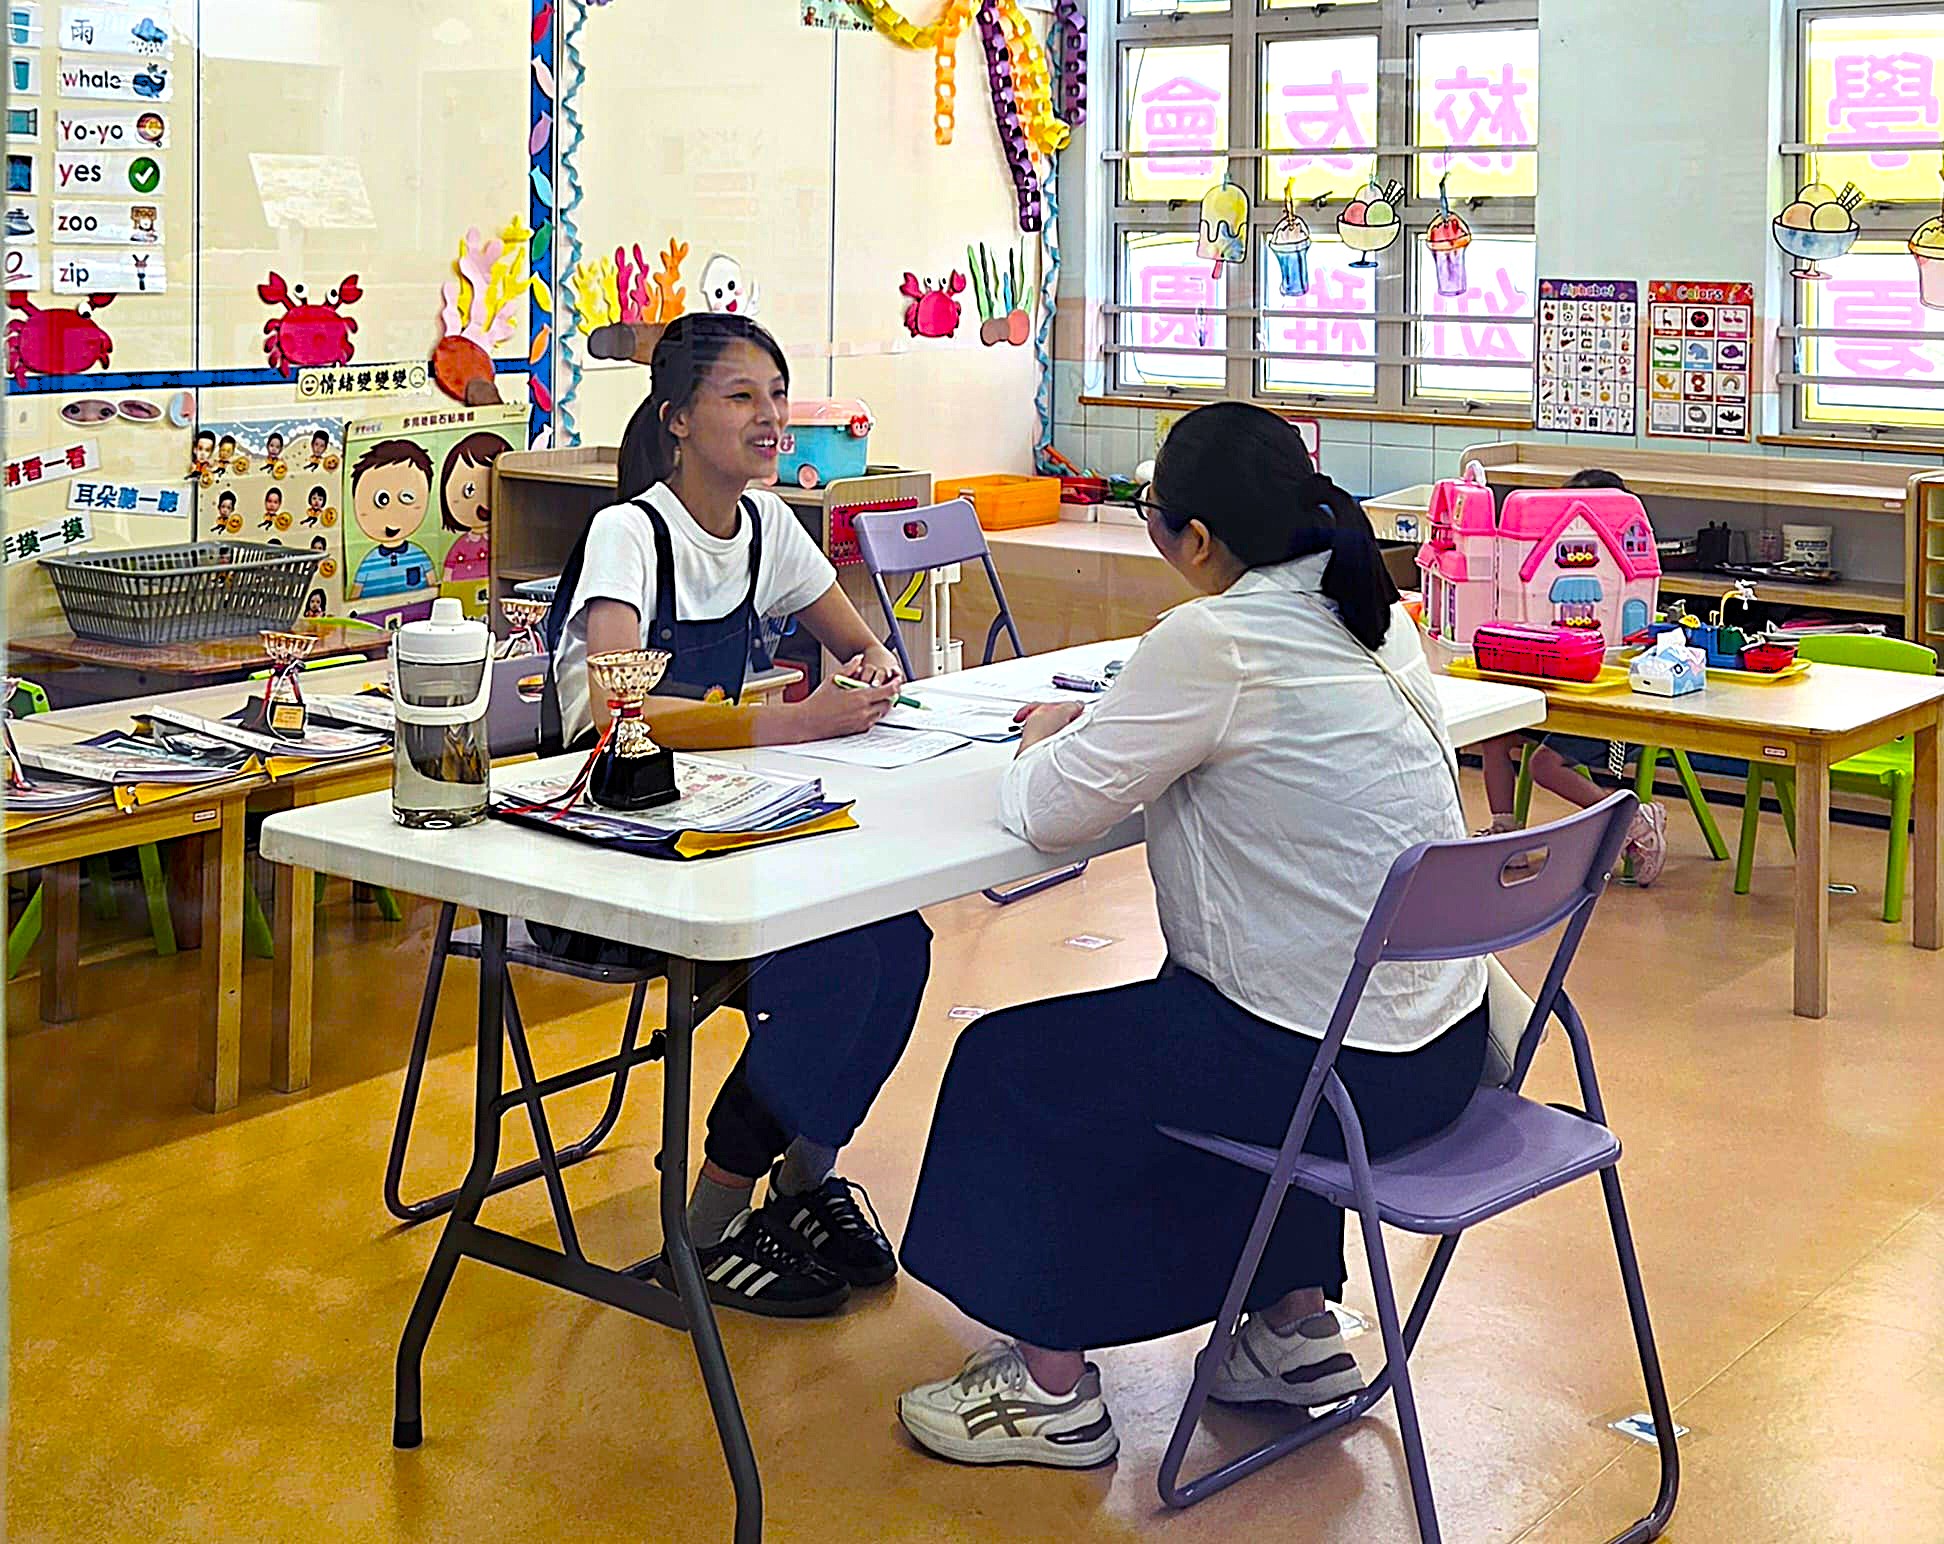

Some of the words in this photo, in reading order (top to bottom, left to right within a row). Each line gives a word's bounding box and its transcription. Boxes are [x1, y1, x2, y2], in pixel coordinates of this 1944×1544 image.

[70, 19, 94, 45] 雨
[62, 69, 122, 90] whale
[58, 161, 102, 187] yes
[57, 214, 98, 232] zoo
[59, 262, 90, 287] zip
[1560, 282, 1615, 298] Alphabet
[1676, 285, 1724, 300] Colors
[319, 368, 408, 395] 情緒變變變
[74, 483, 180, 513] 耳朵聽一聽
